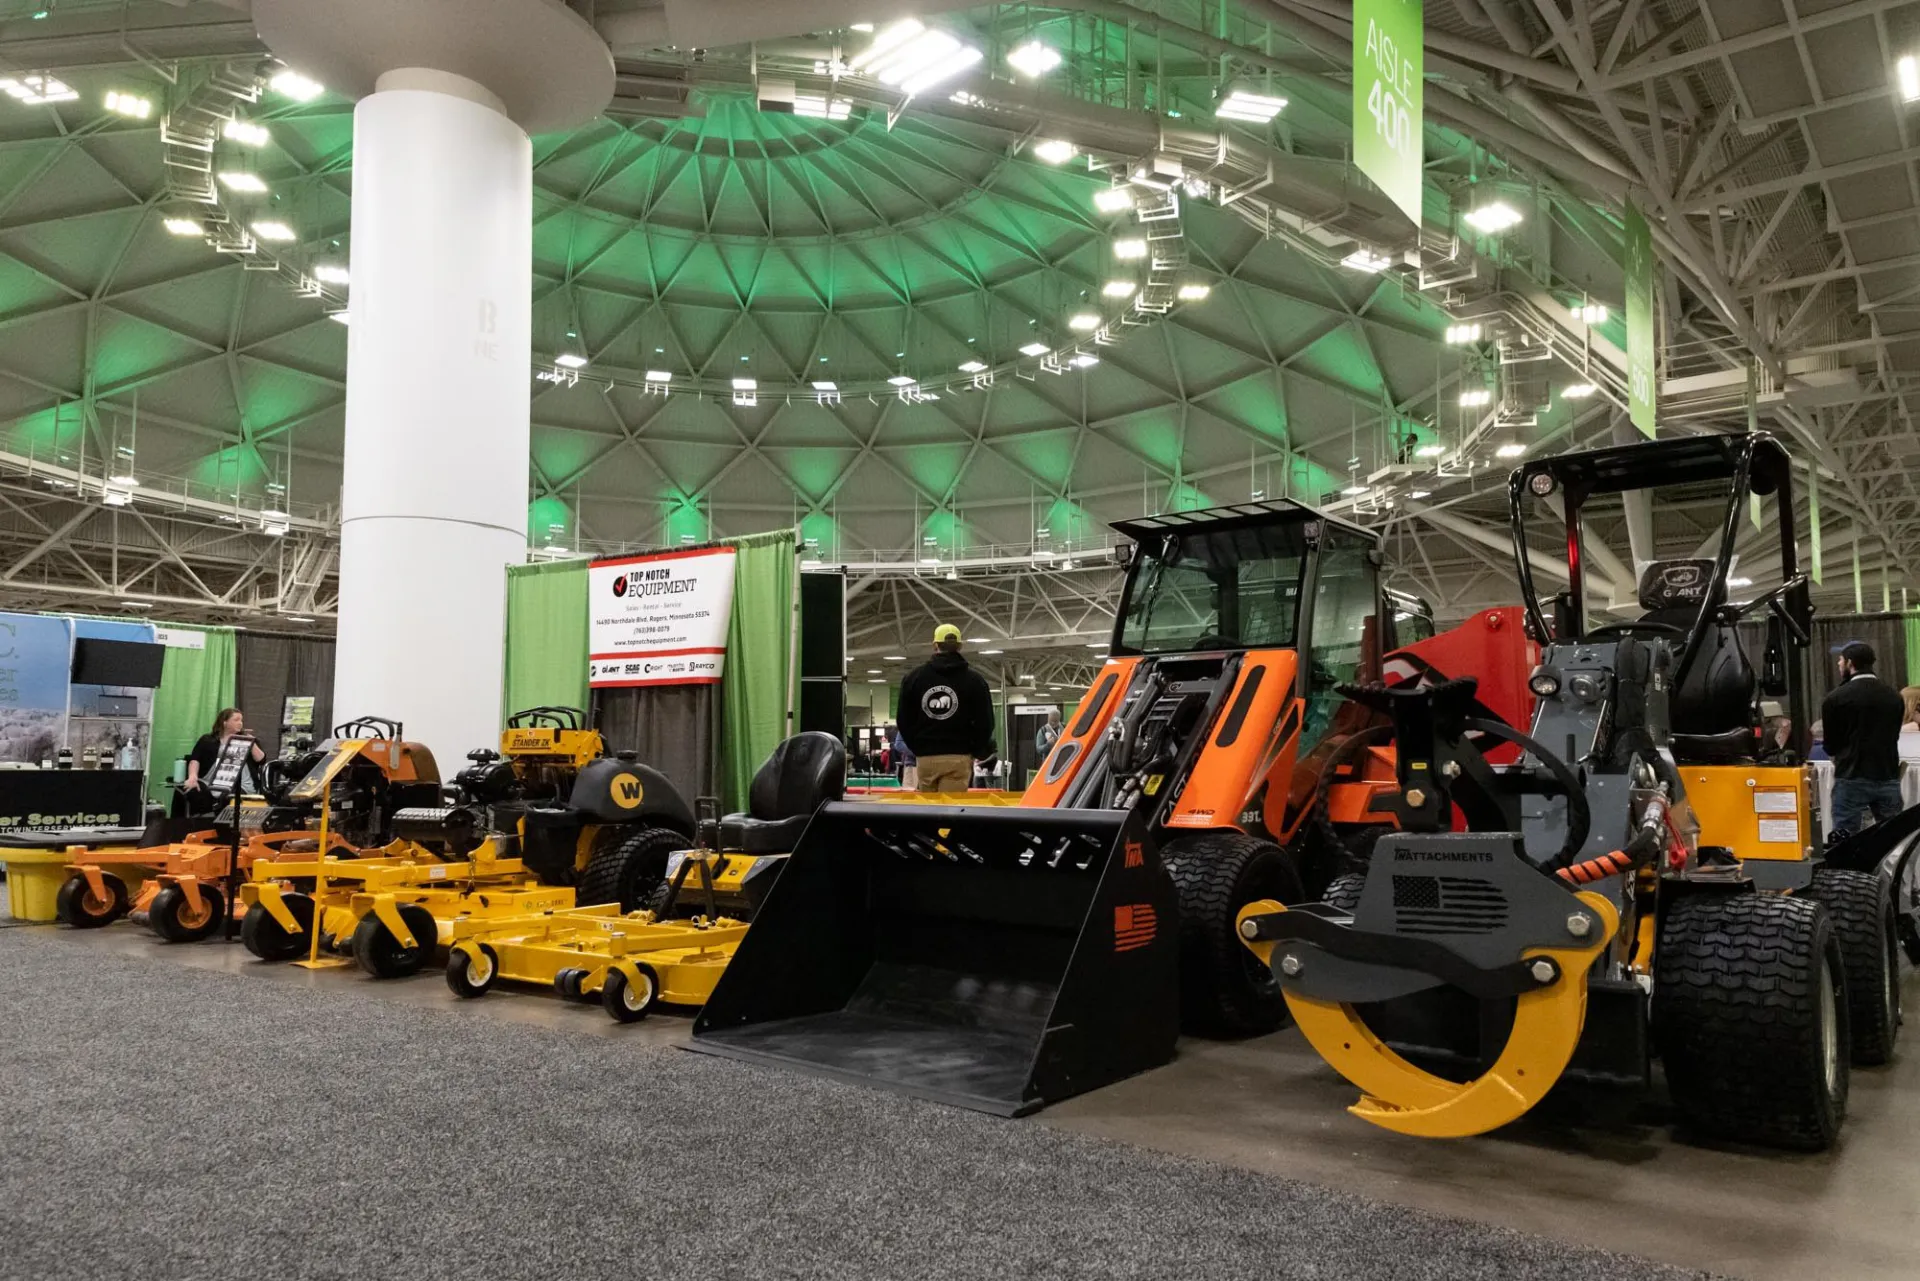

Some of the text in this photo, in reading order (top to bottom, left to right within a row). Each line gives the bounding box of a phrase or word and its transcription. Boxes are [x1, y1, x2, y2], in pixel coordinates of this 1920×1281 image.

[1365, 17, 1414, 108] AISLE
[1368, 78, 1410, 158] 400
[630, 568, 670, 582] TOP NOTCH
[628, 578, 697, 598] EQUIPMENT
[512, 739, 541, 747] STANDER
[27, 812, 121, 825] Services
